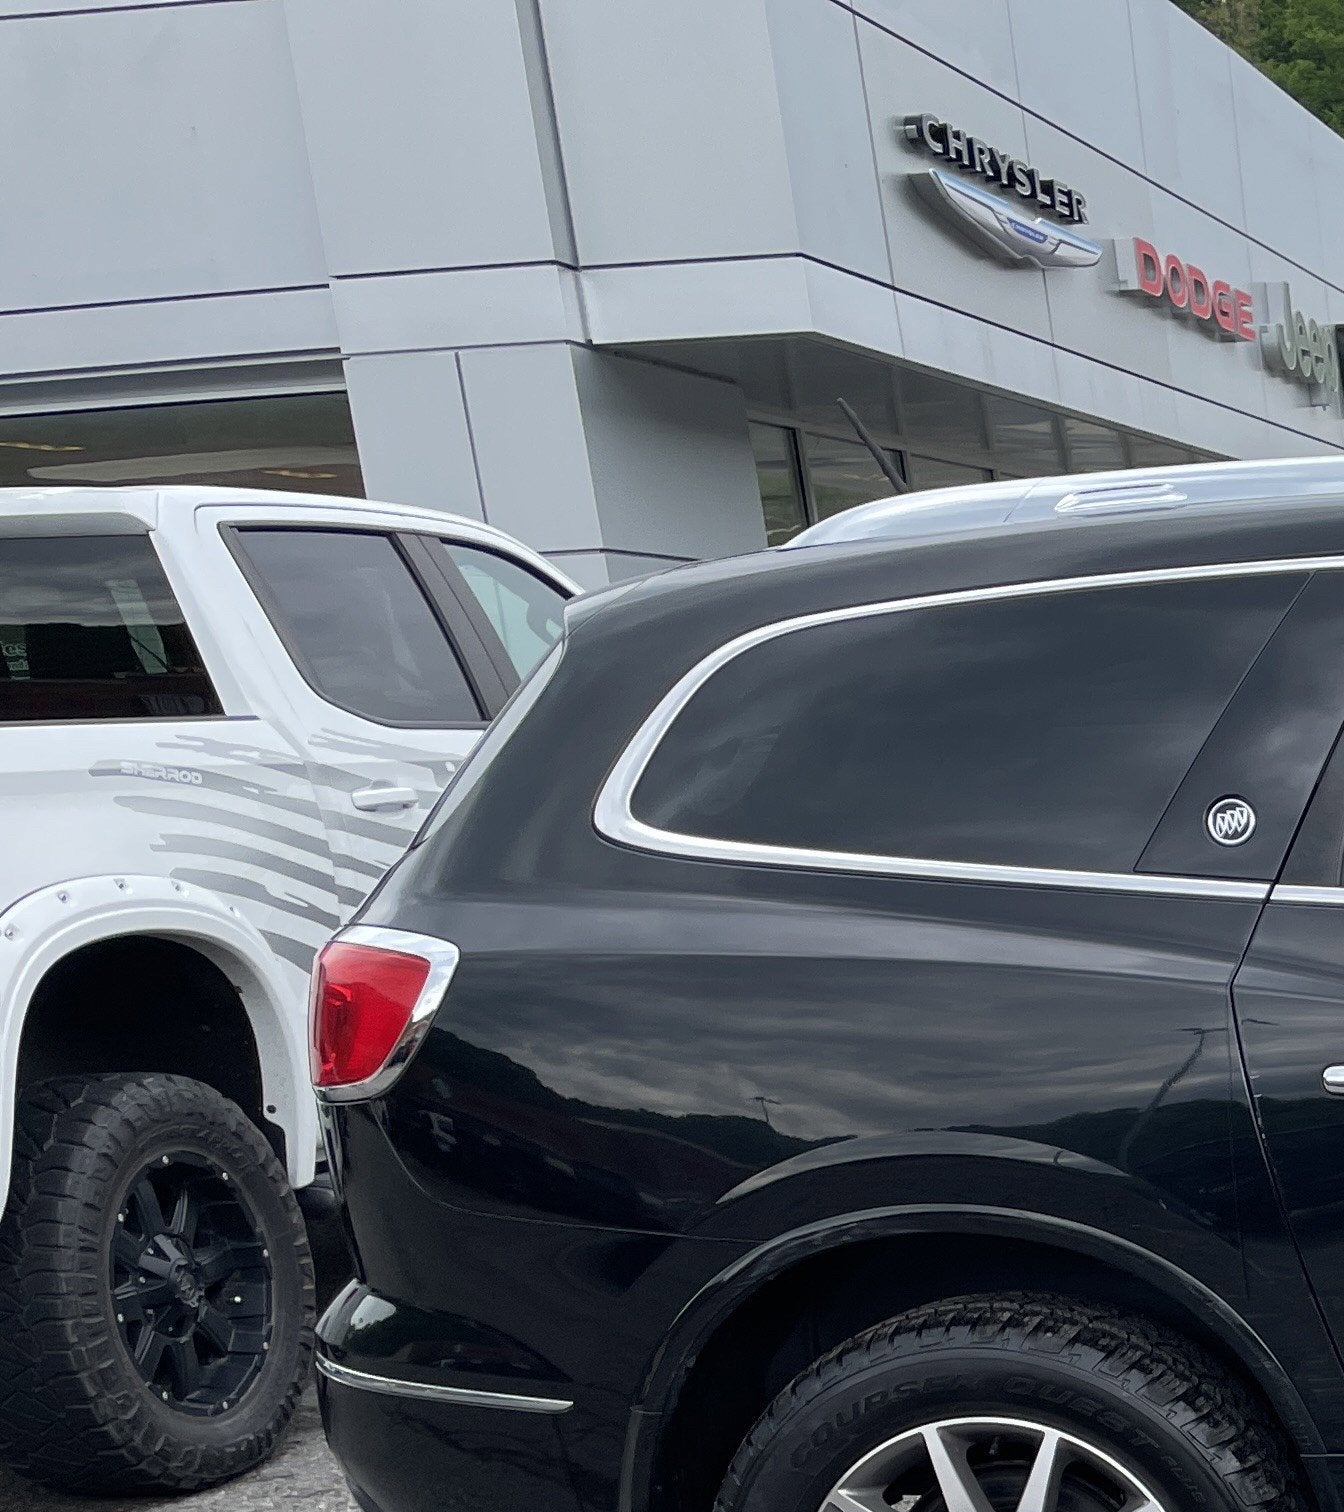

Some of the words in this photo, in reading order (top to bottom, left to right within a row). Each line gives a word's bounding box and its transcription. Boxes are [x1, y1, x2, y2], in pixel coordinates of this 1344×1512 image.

[903, 113, 1089, 225] CHRYSLER
[1130, 237, 1257, 342] DODGE
[119, 761, 203, 785] SHERROD
[1001, 1375, 1160, 1450] QUEST
